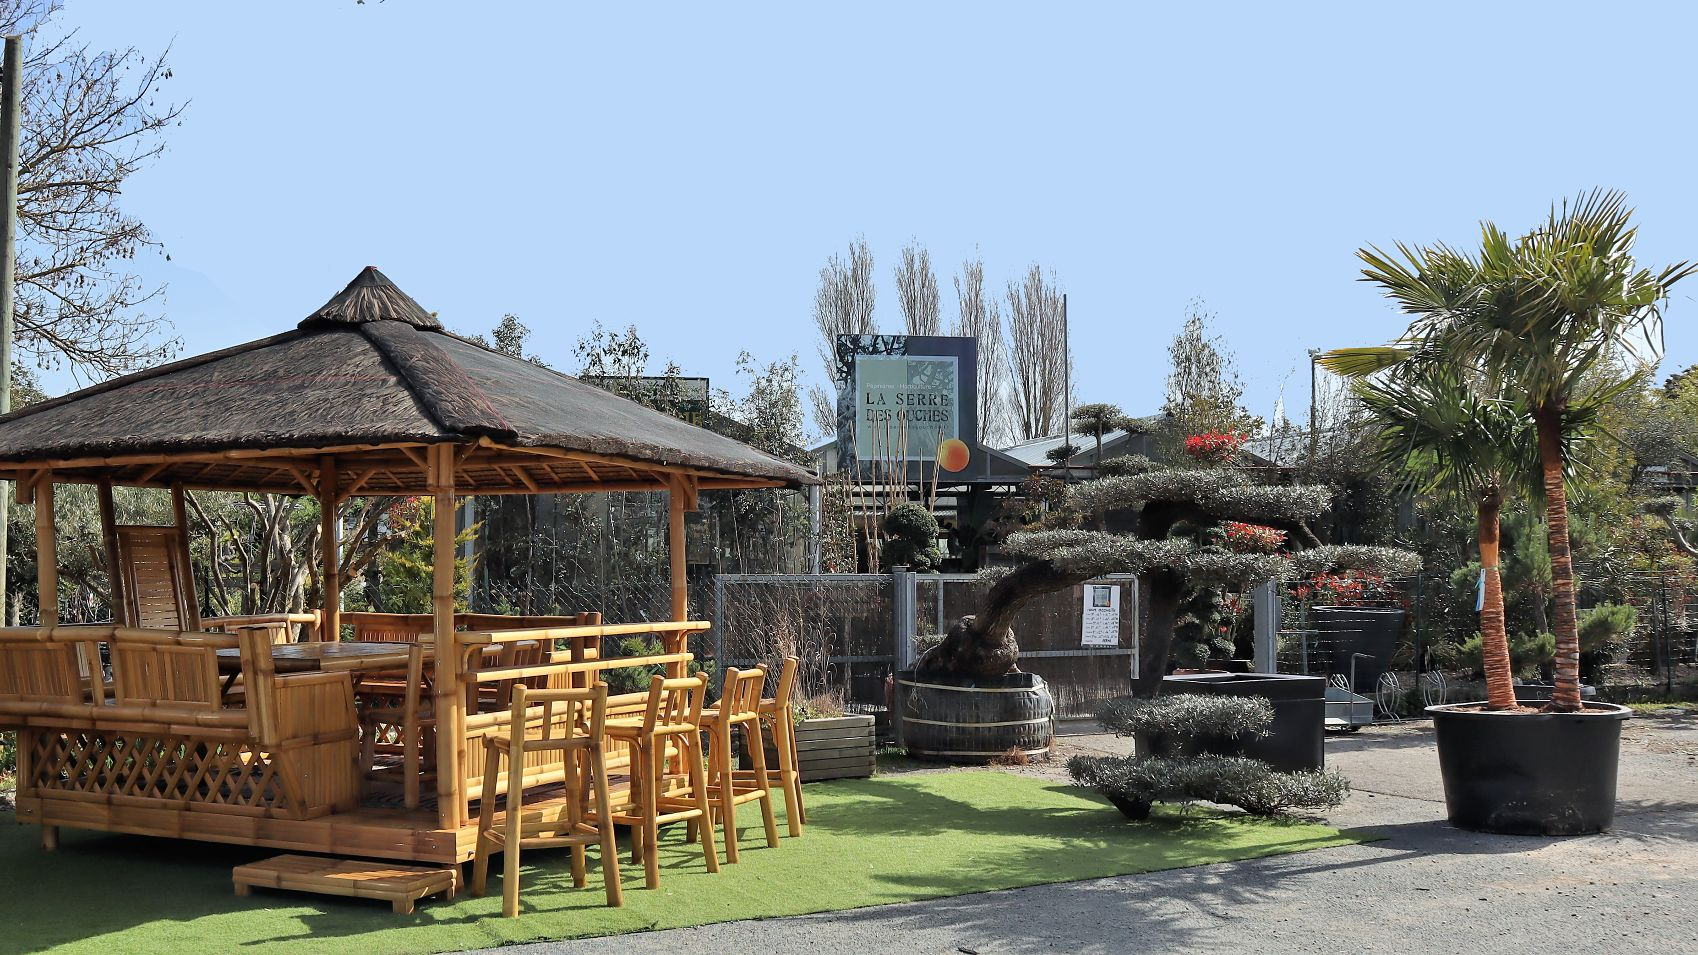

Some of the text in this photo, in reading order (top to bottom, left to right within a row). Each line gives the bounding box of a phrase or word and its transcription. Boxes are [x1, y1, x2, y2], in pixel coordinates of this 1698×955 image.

[866, 392, 949, 406] LA SERRE
[866, 409, 949, 422] DES OUCHES
